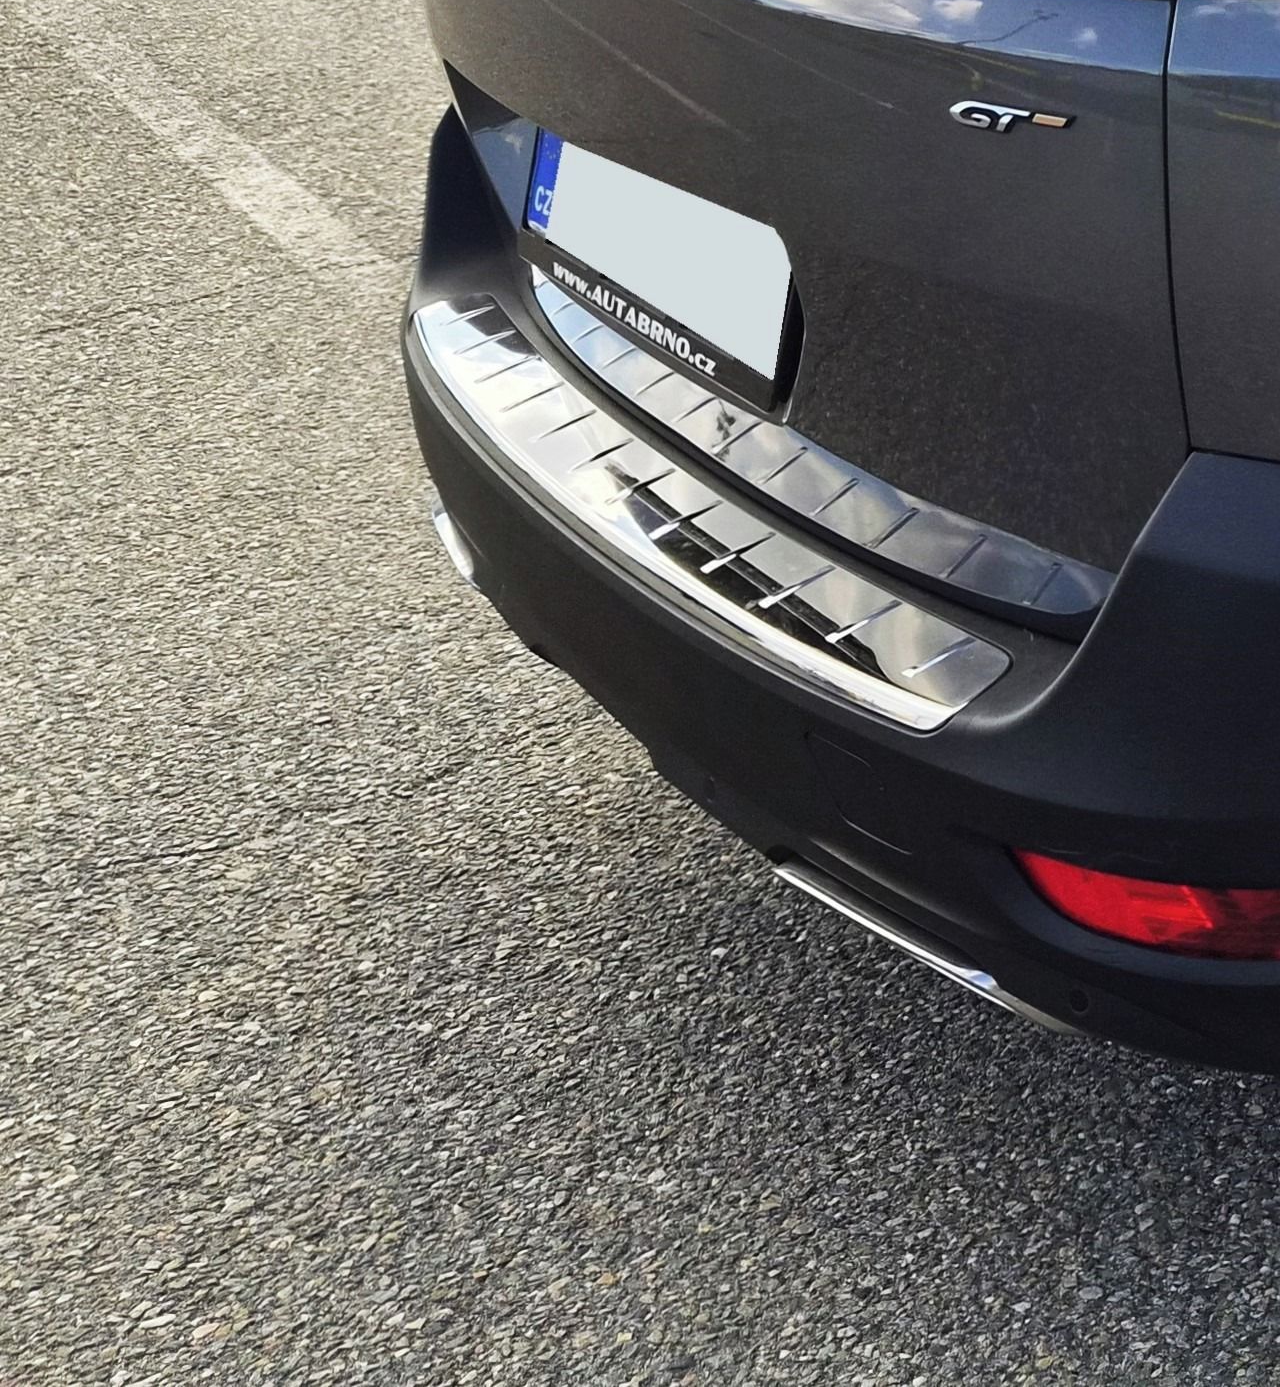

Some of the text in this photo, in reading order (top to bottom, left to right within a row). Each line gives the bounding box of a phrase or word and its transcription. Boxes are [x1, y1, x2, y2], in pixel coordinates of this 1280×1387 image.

[949, 100, 1031, 132] GT
[534, 185, 556, 216] CZ
[552, 262, 718, 377] www.AUTABRNO.cz
